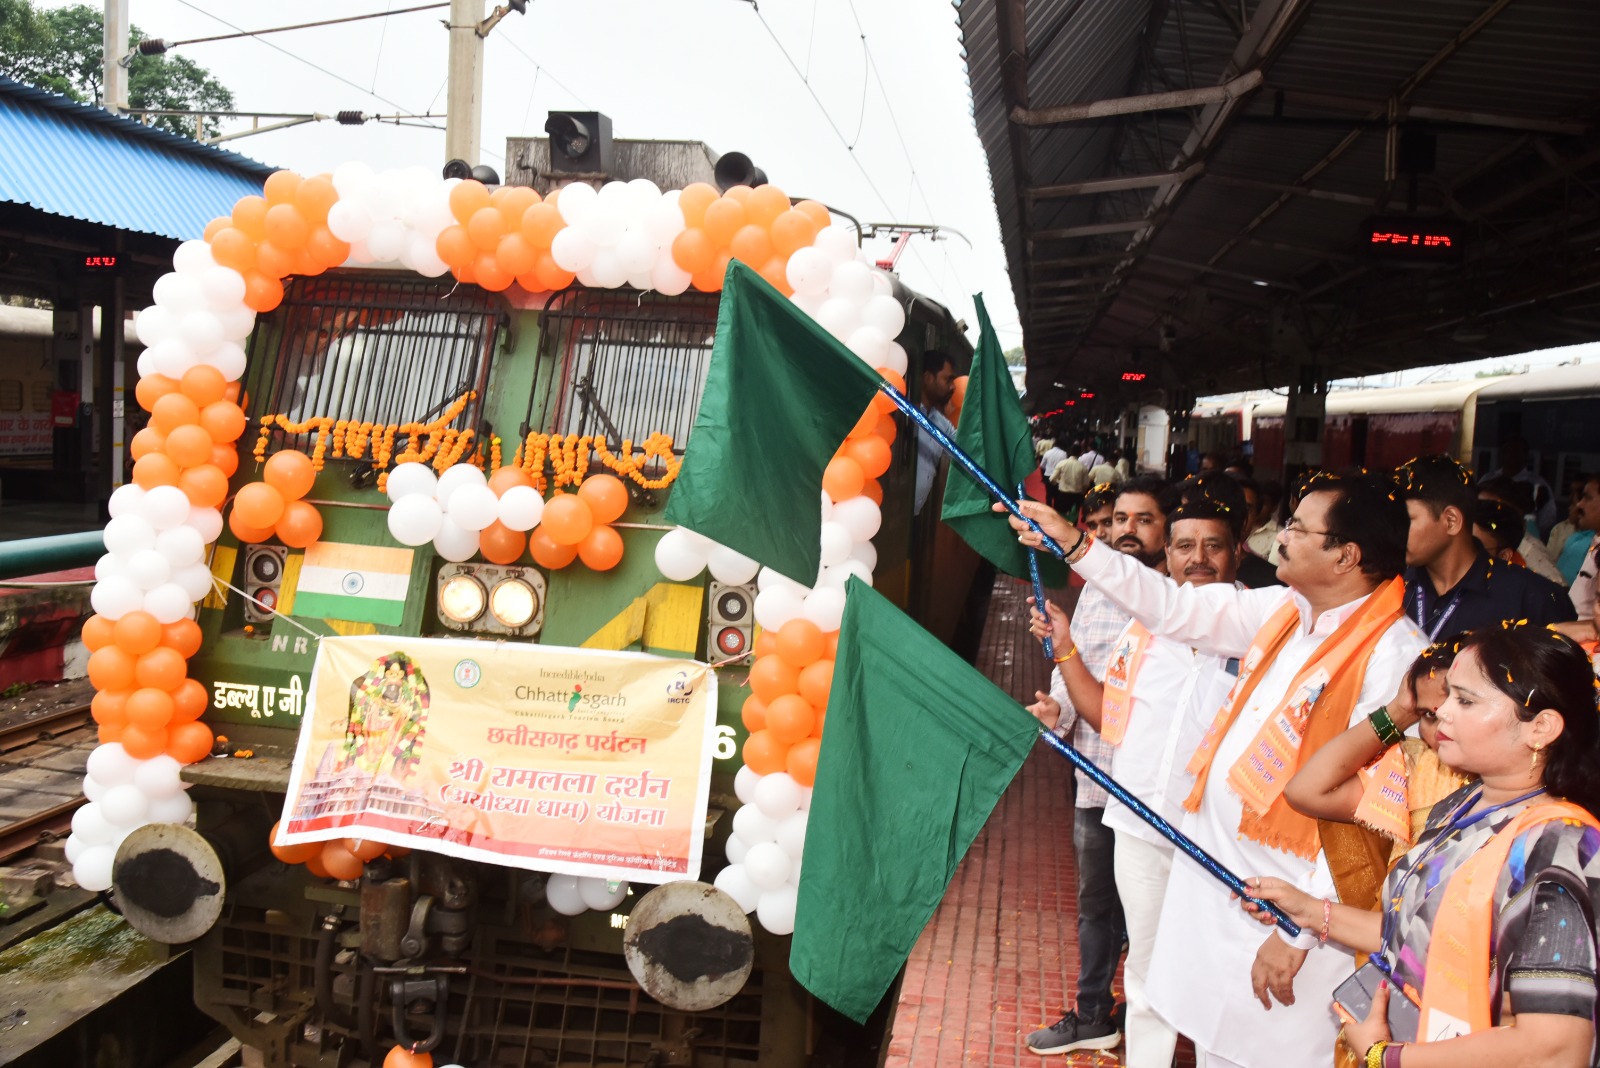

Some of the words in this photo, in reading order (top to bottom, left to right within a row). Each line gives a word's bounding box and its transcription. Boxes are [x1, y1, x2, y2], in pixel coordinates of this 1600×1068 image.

[515, 683, 627, 712] Chhattisgarh
[487, 724, 580, 754] छत्तीसगढ़
[585, 730, 648, 754] पर्यटन
[449, 759, 484, 782] श्री
[492, 767, 598, 794] रामलला
[605, 771, 671, 799] दर्शन
[439, 784, 532, 814] (अयोध्या
[536, 798, 590, 823] धाम)
[596, 801, 667, 826] योजना
